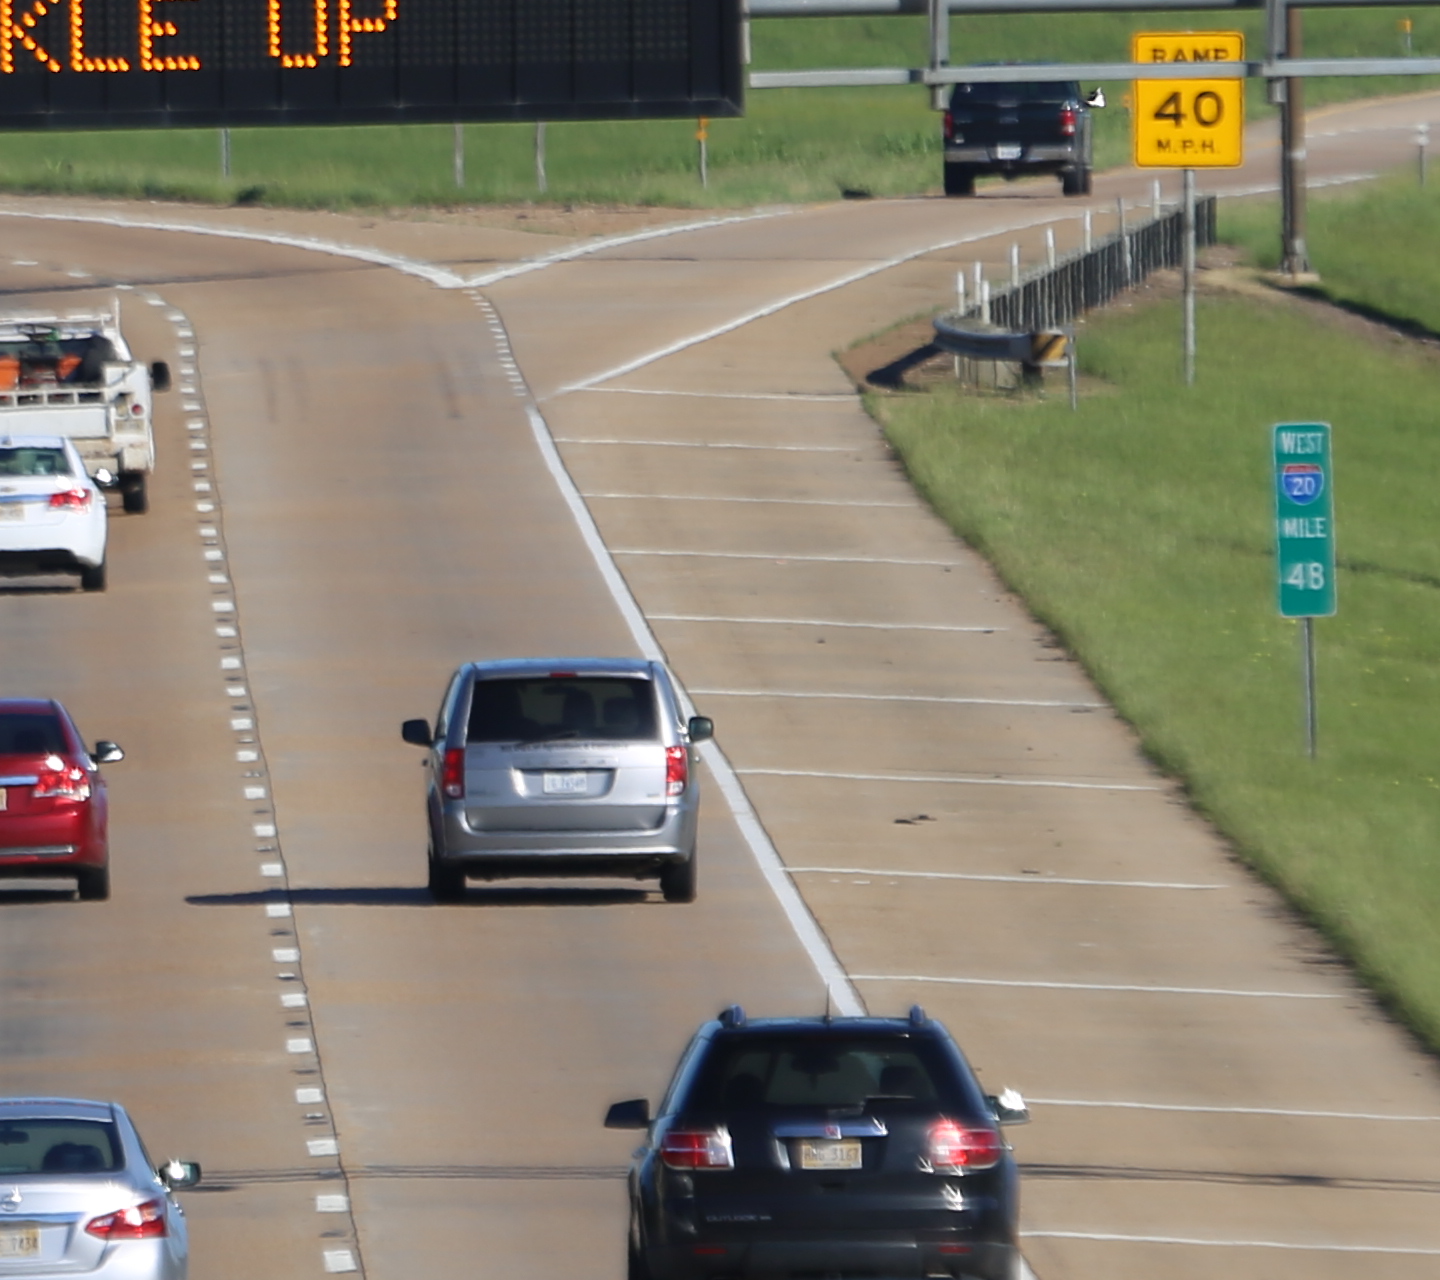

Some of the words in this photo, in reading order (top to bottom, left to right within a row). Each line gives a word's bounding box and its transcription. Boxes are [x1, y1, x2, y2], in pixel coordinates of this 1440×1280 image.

[1152, 48, 1229, 63] RAMP
[1153, 90, 1225, 129] 40
[1281, 432, 1324, 455] WEST
[1292, 477, 1316, 496] 20
[1283, 517, 1327, 538] MILE
